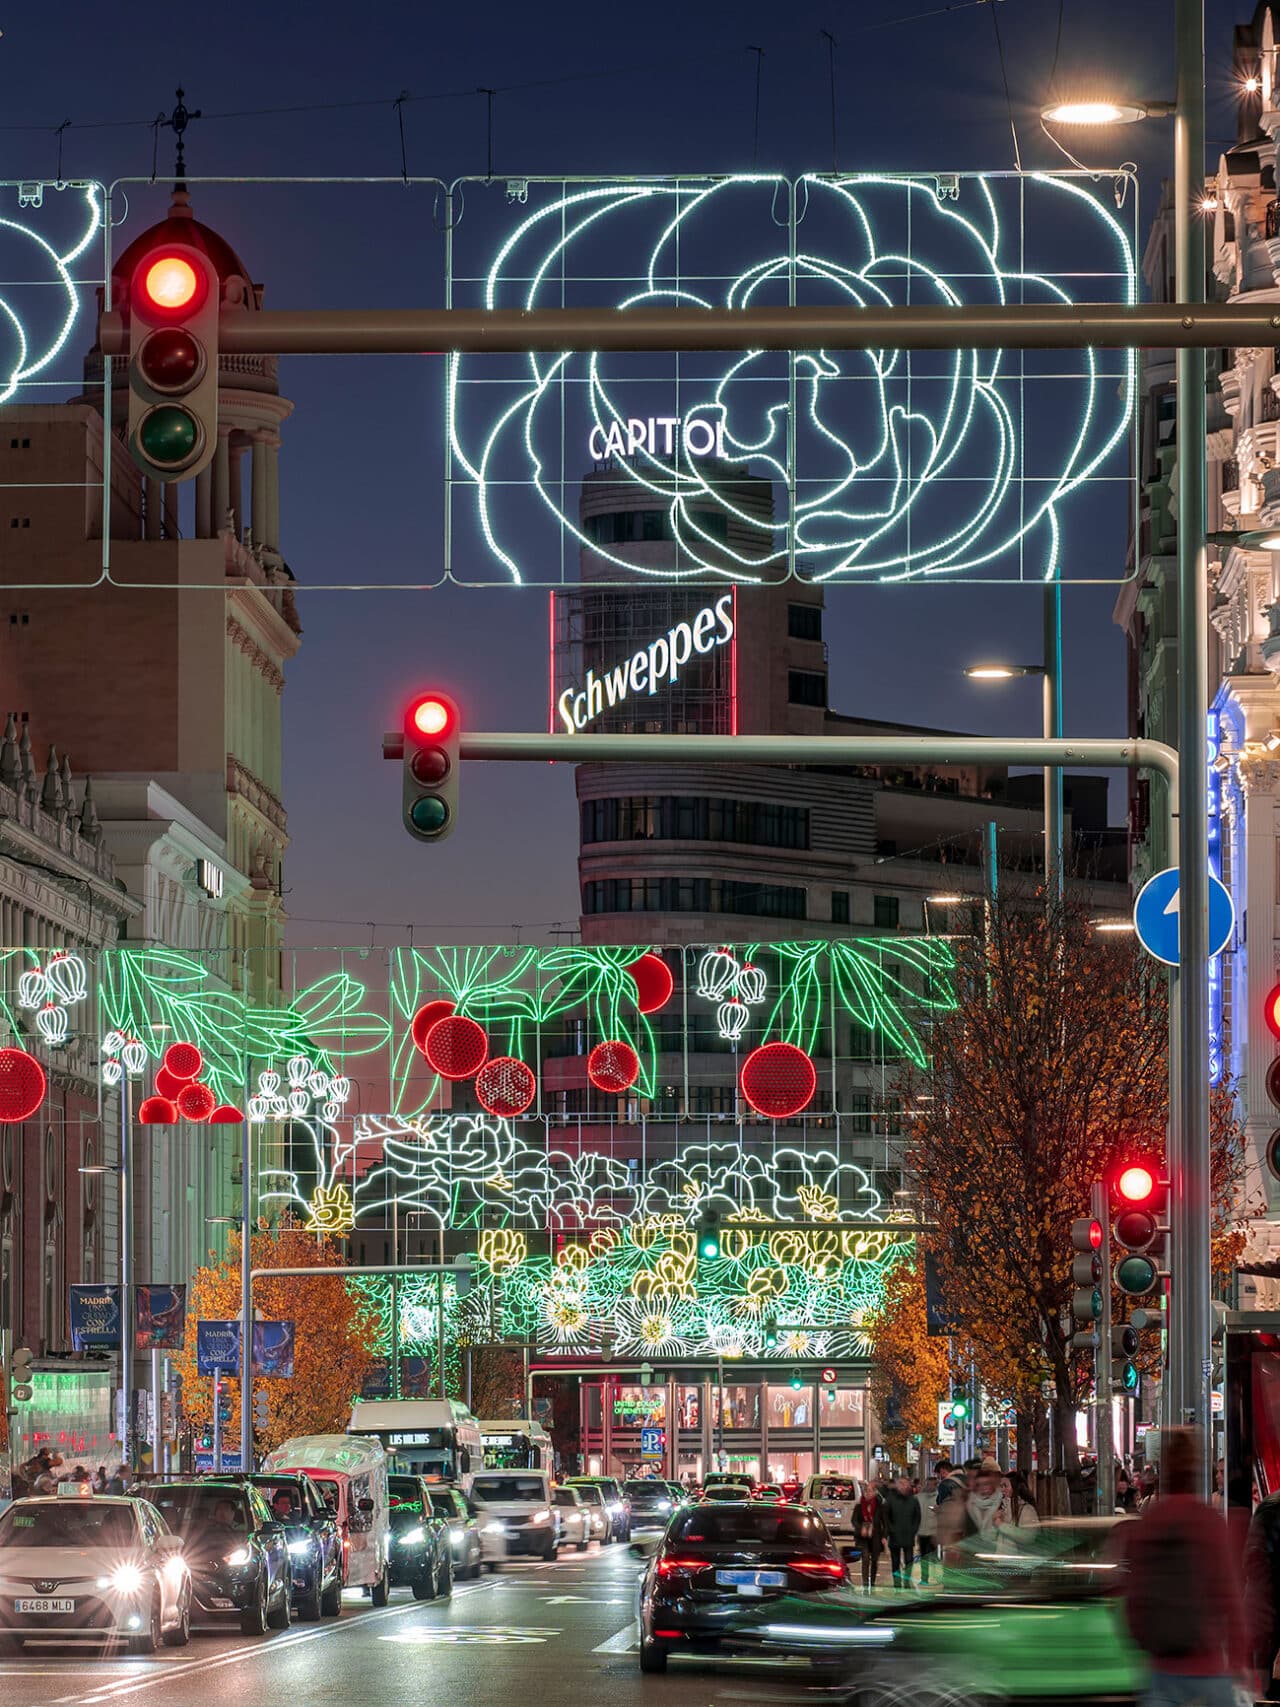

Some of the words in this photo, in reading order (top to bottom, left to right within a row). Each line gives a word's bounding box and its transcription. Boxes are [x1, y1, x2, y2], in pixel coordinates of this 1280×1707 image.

[589, 416, 729, 460] CAPITOL
[558, 594, 735, 734] Schweppes
[80, 1297, 113, 1305] MADRID
[86, 1319, 106, 1327] CON
[22, 1601, 49, 1611] 6468
[51, 1601, 72, 1611] MLD
